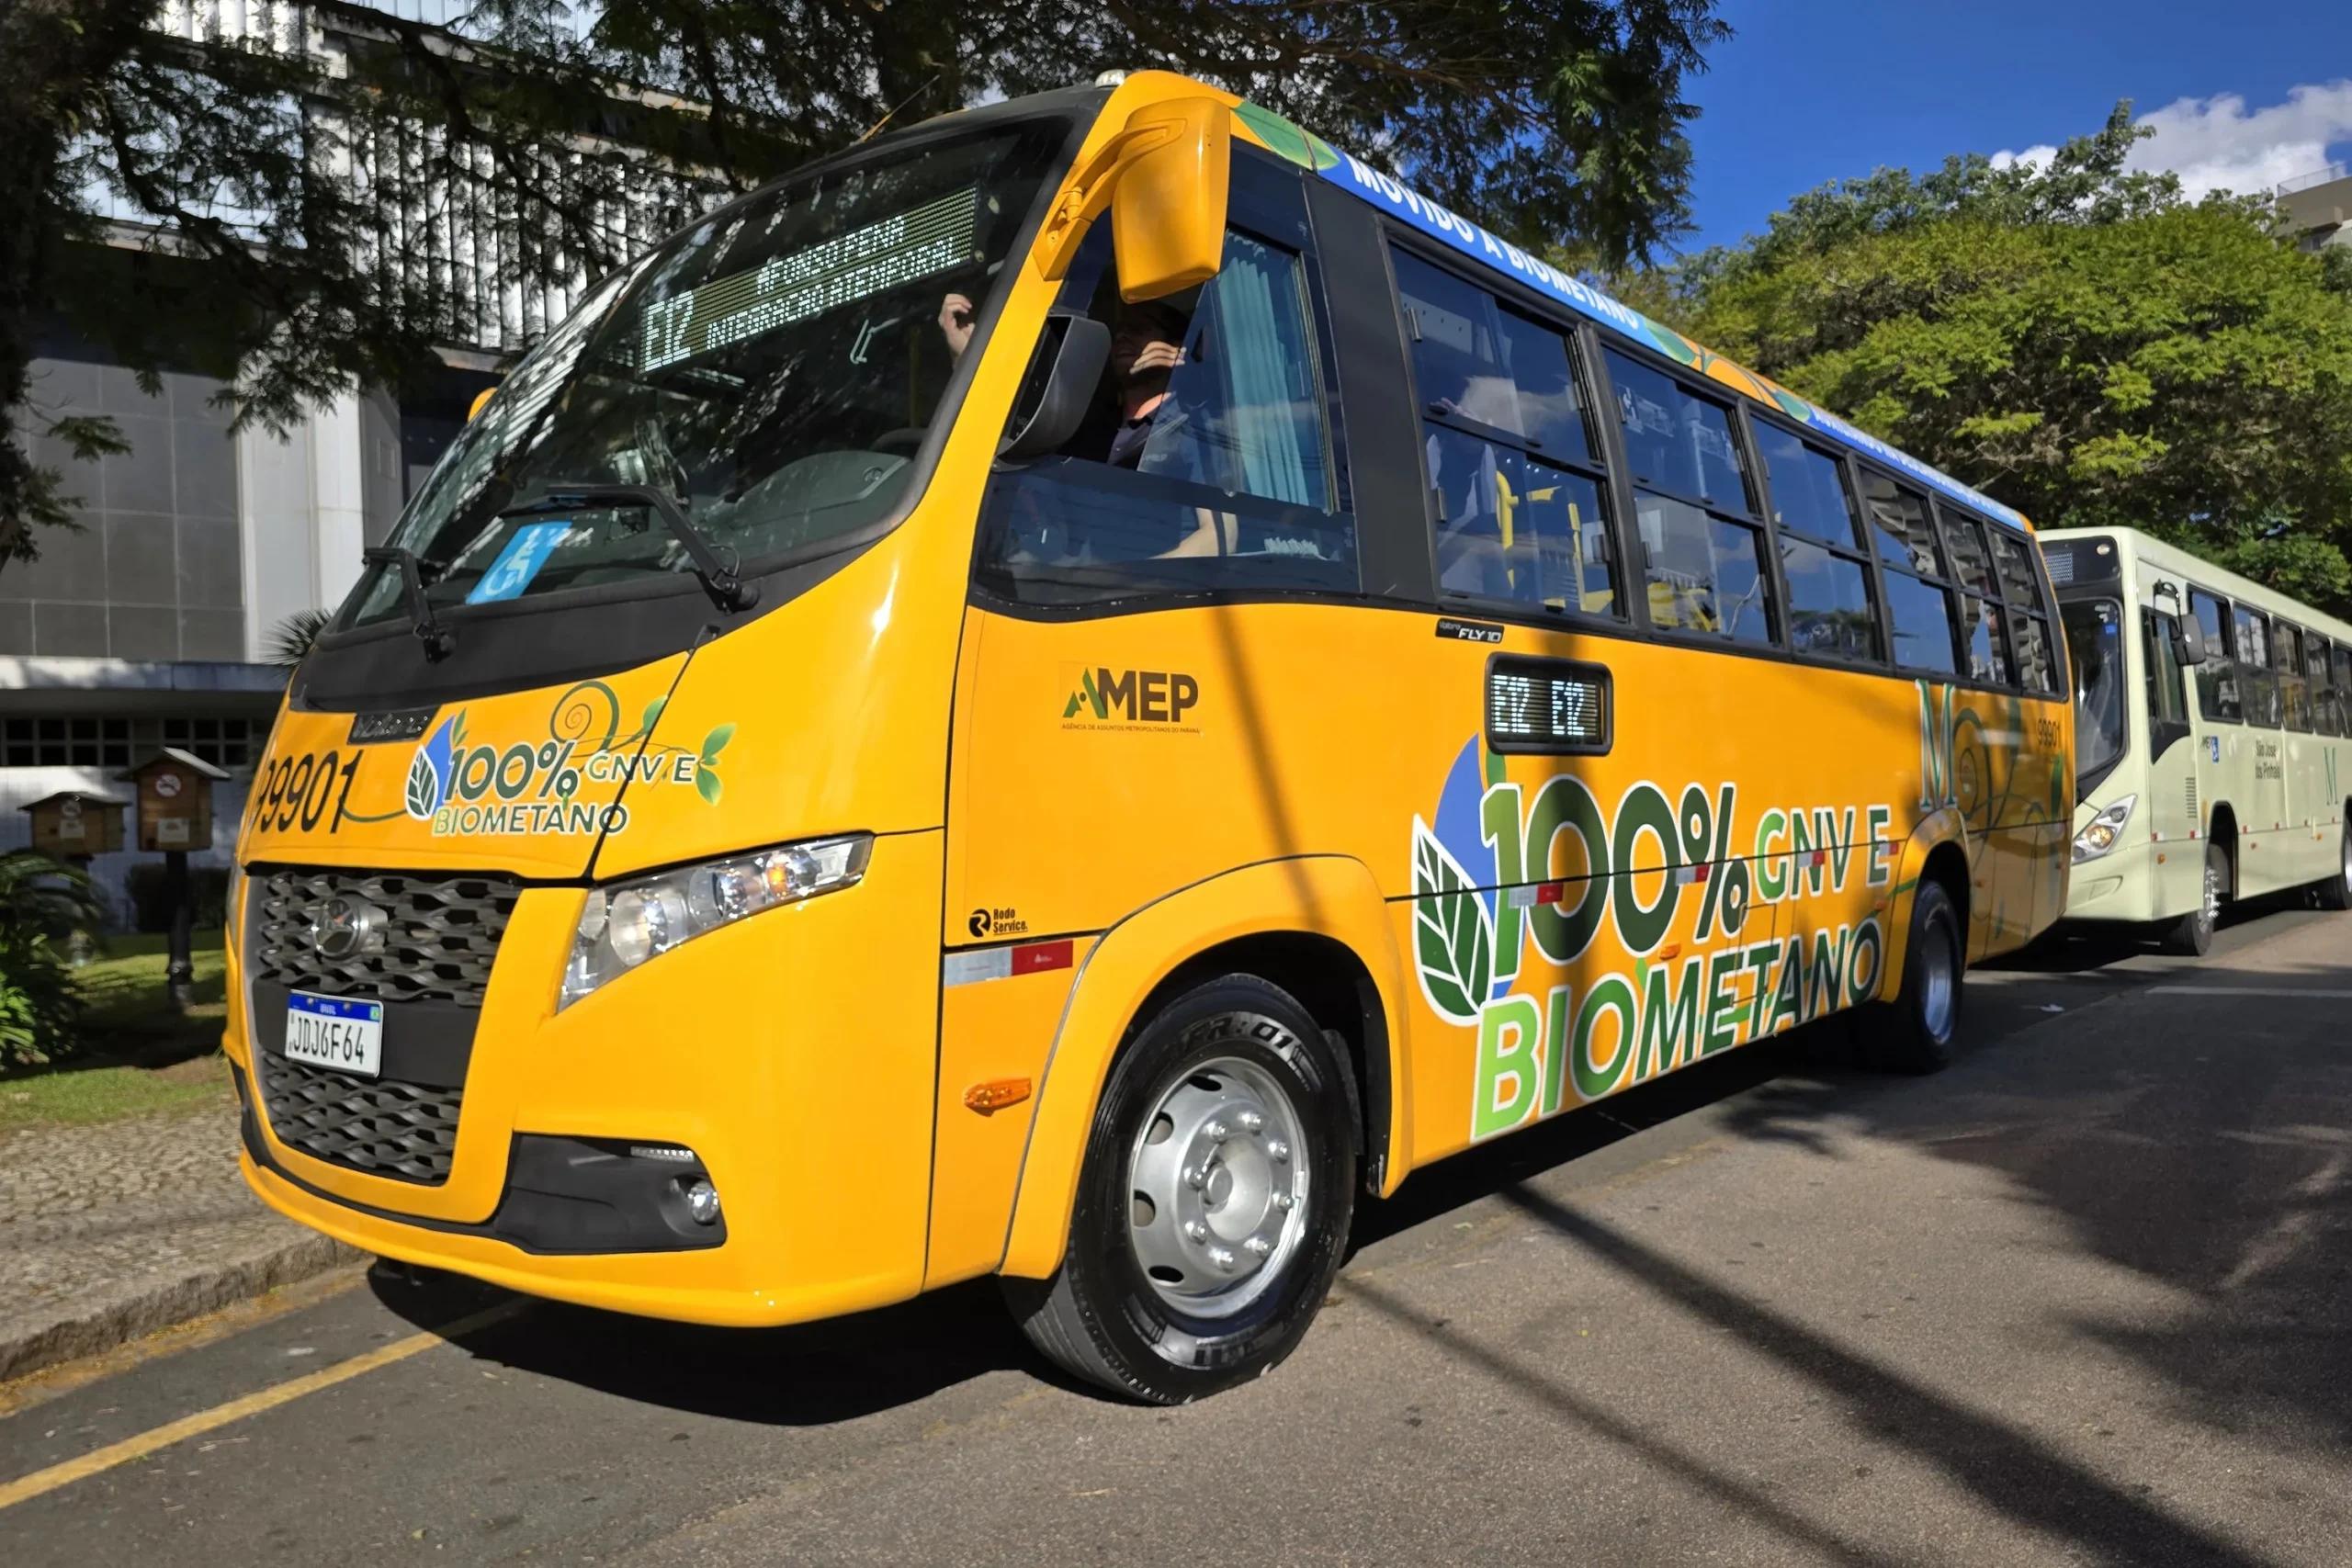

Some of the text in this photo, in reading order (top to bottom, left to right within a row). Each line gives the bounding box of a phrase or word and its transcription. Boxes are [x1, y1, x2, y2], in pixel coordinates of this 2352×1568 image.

[757, 216, 906, 296] AFONSO PENA
[1344, 152, 1640, 331] MOVIDO A BIOMETANO
[644, 290, 695, 371] E12
[1459, 627, 1502, 642] FLY 10
[1062, 666, 1199, 722] AMEP
[1061, 722, 1087, 731] AGÊNCIA
[1097, 724, 1125, 732] ASSUNTOS
[1180, 726, 1200, 734] PARANÁ
[444, 739, 700, 801] 100% GNV E
[432, 802, 629, 837] BIOMETANO
[1480, 773, 1892, 966] 100% GNV E
[993, 908, 1016, 919] Rodo
[1470, 919, 1882, 1142] BIOMETANO
